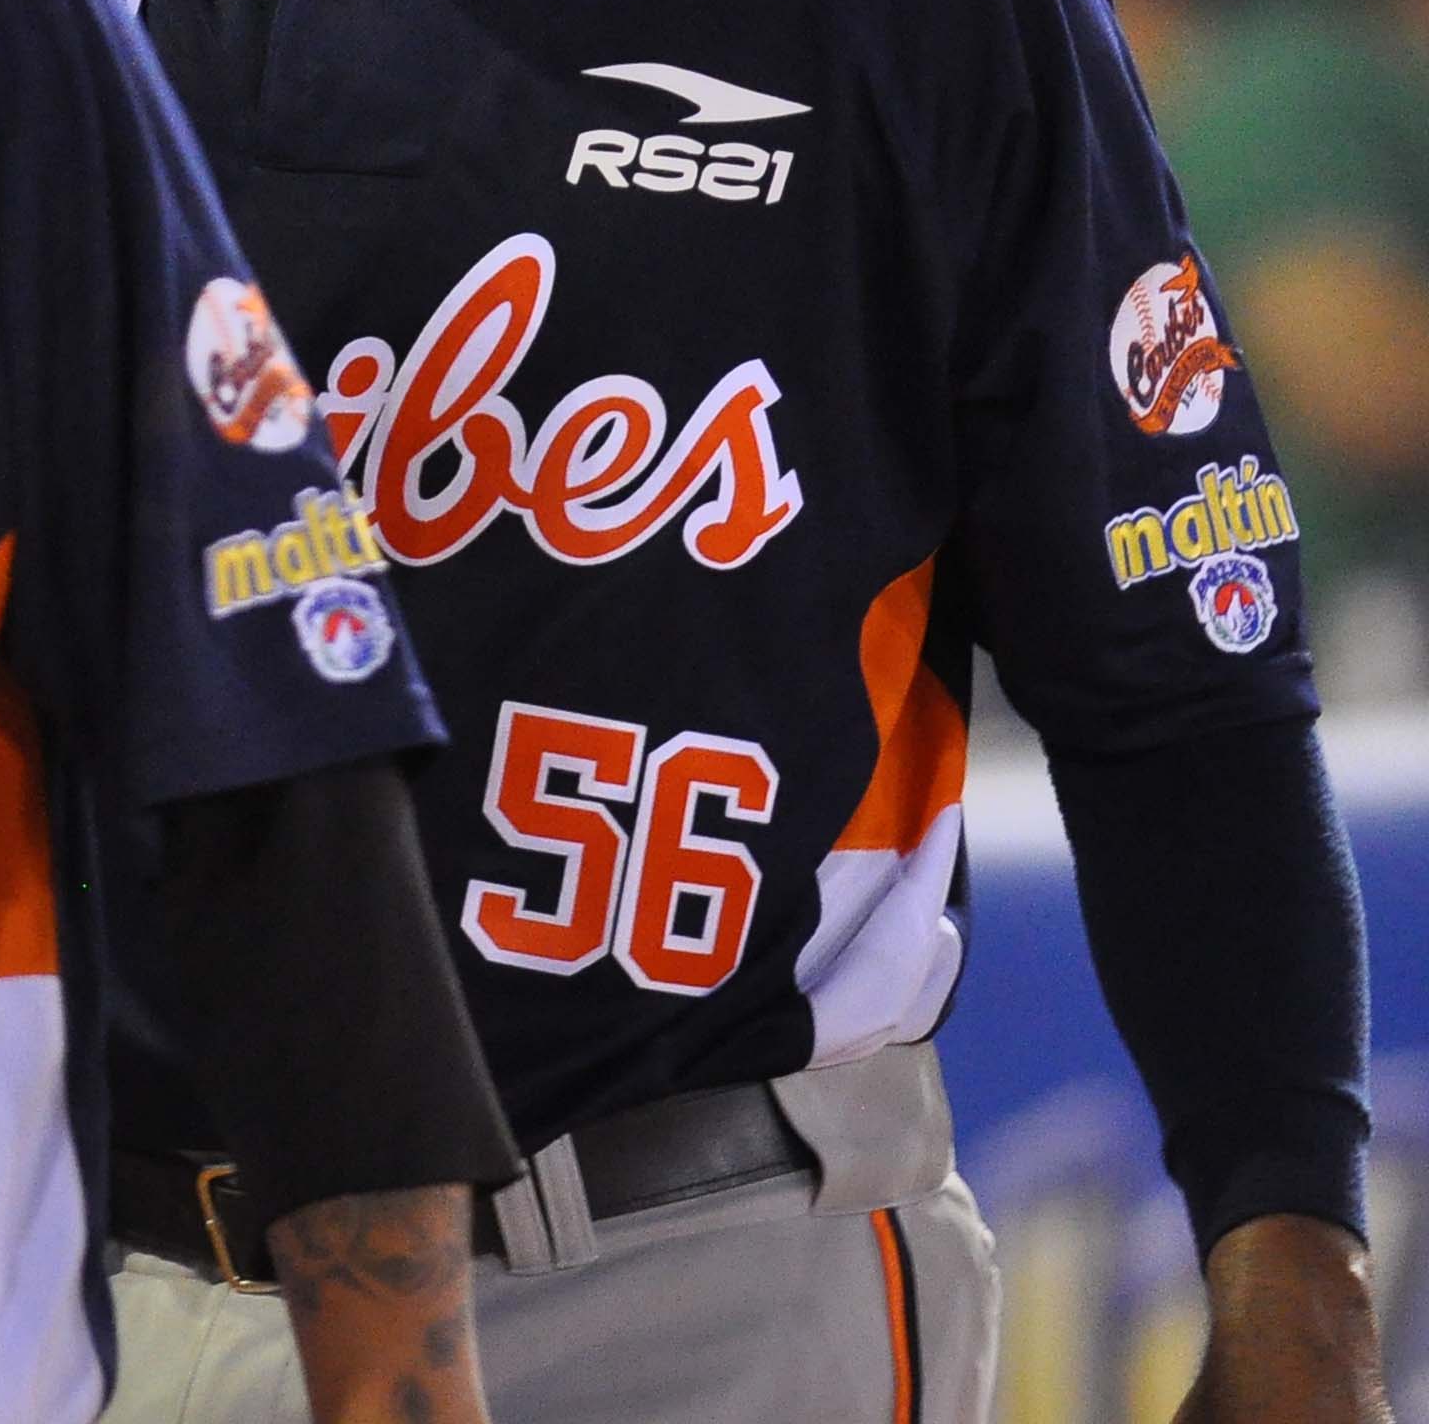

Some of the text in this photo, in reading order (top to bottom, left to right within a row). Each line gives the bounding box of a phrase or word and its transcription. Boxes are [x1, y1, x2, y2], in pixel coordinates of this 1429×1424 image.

[566, 129, 795, 205] RS21
[1107, 458, 1297, 588] maltín
[461, 700, 779, 997] 56
